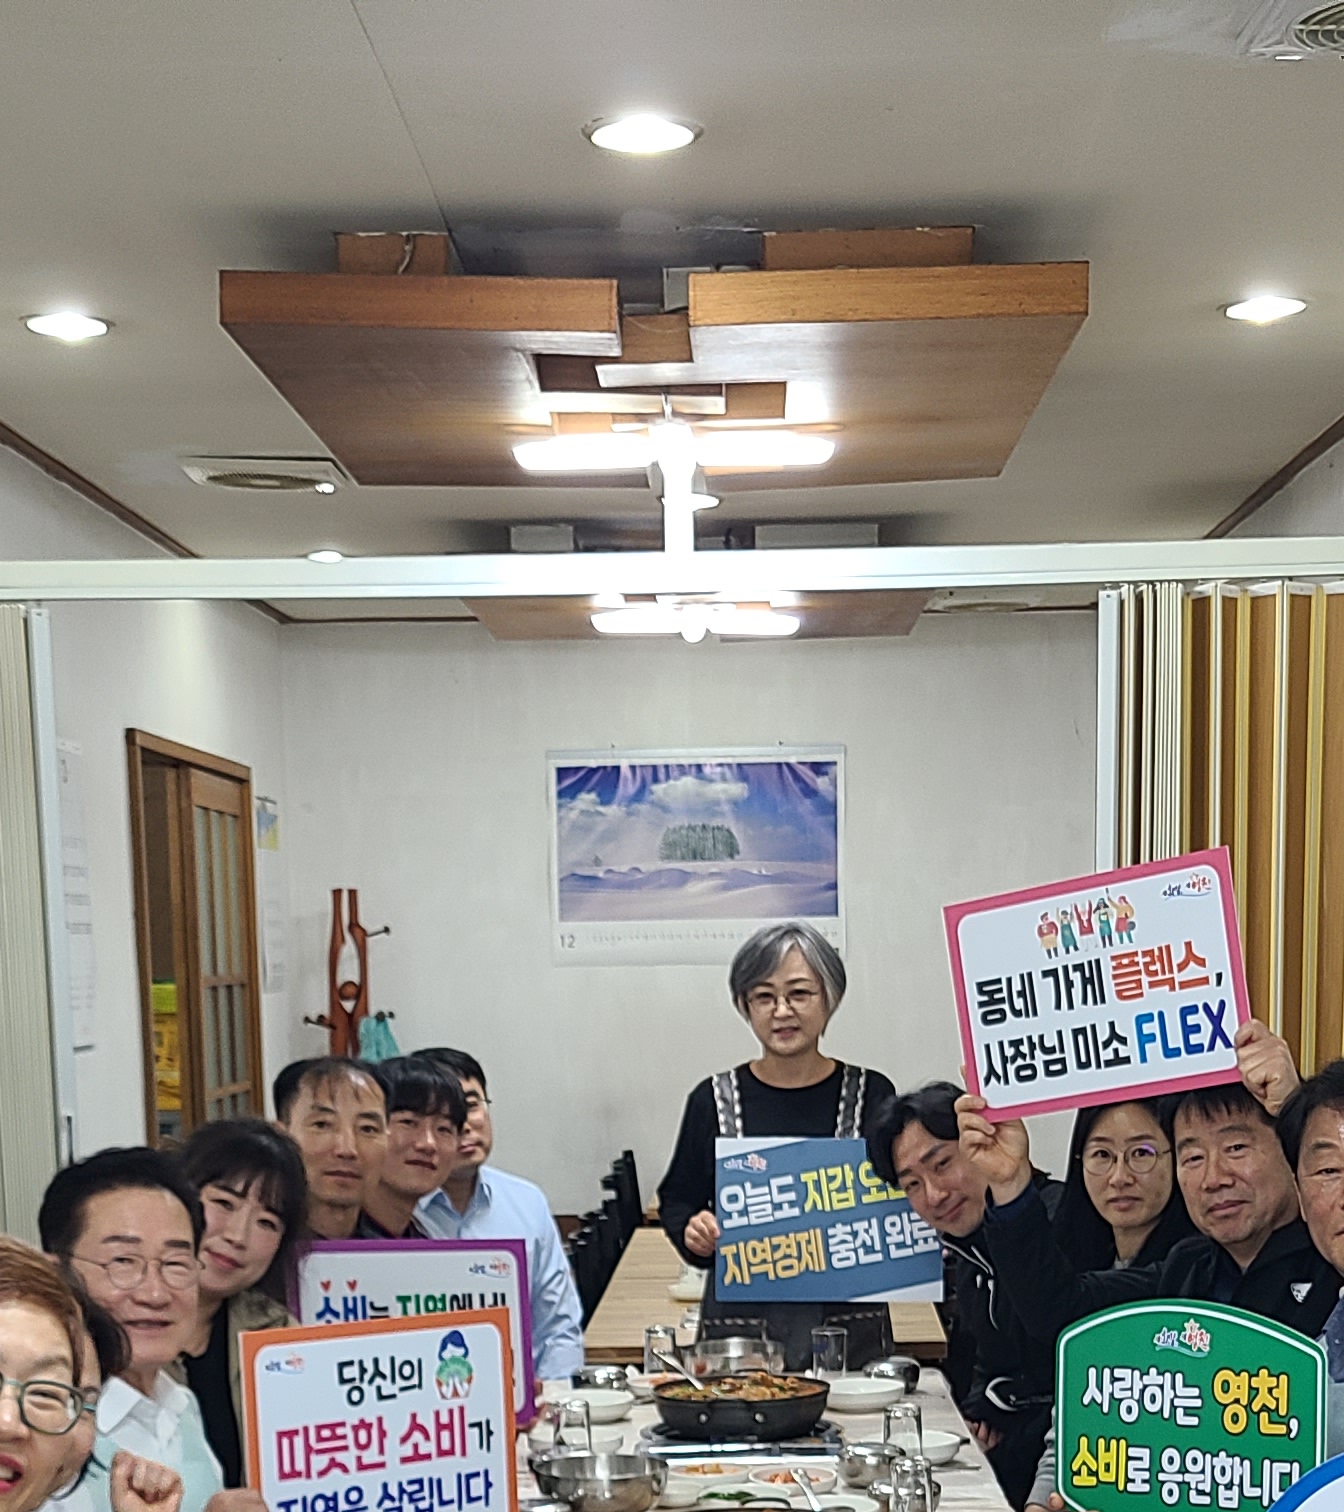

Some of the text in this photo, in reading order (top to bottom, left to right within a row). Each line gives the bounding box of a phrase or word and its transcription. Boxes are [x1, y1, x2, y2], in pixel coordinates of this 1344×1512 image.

[974, 940, 1224, 1027] 동네 가게 플렉스,
[983, 998, 1236, 1088] 사장님 미소 FLEX
[719, 1174, 801, 1230] 오늘도
[799, 1162, 857, 1213] 지갑
[719, 1227, 827, 1287] 지역경제
[827, 1216, 885, 1270] 충전
[337, 1355, 424, 1408] 당신의
[1082, 1366, 1301, 1440] 사랑하는 영천,
[275, 1403, 495, 1484] 따뜻한 소비가
[1070, 1434, 1152, 1494] 소비로
